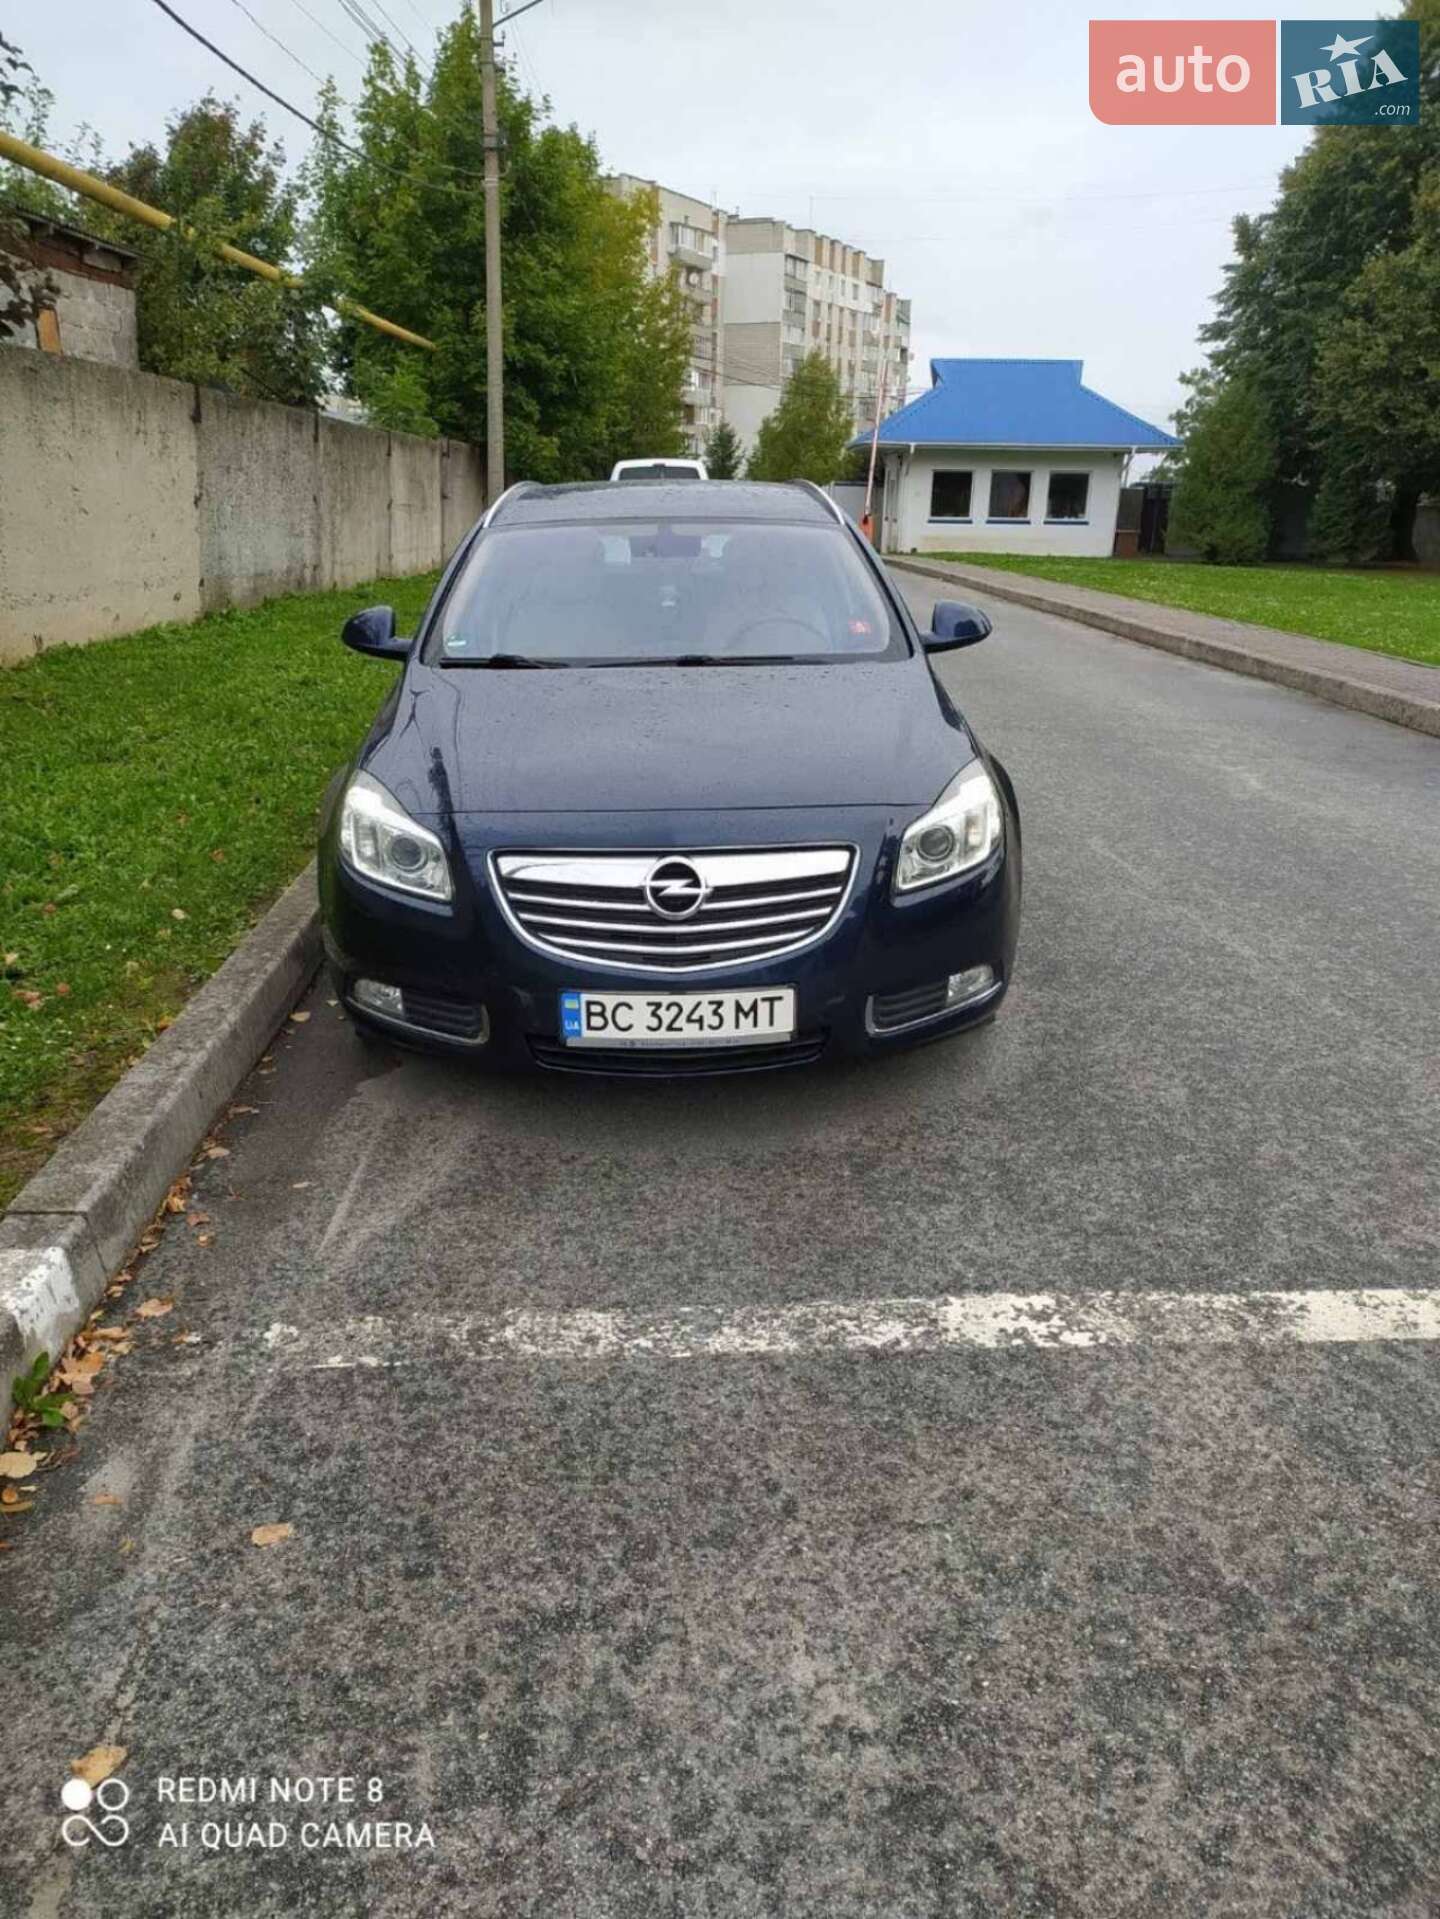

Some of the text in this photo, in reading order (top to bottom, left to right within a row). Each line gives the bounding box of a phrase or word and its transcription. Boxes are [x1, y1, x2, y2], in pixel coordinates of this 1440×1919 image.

[585, 996, 784, 1032] BC 3243 MT
